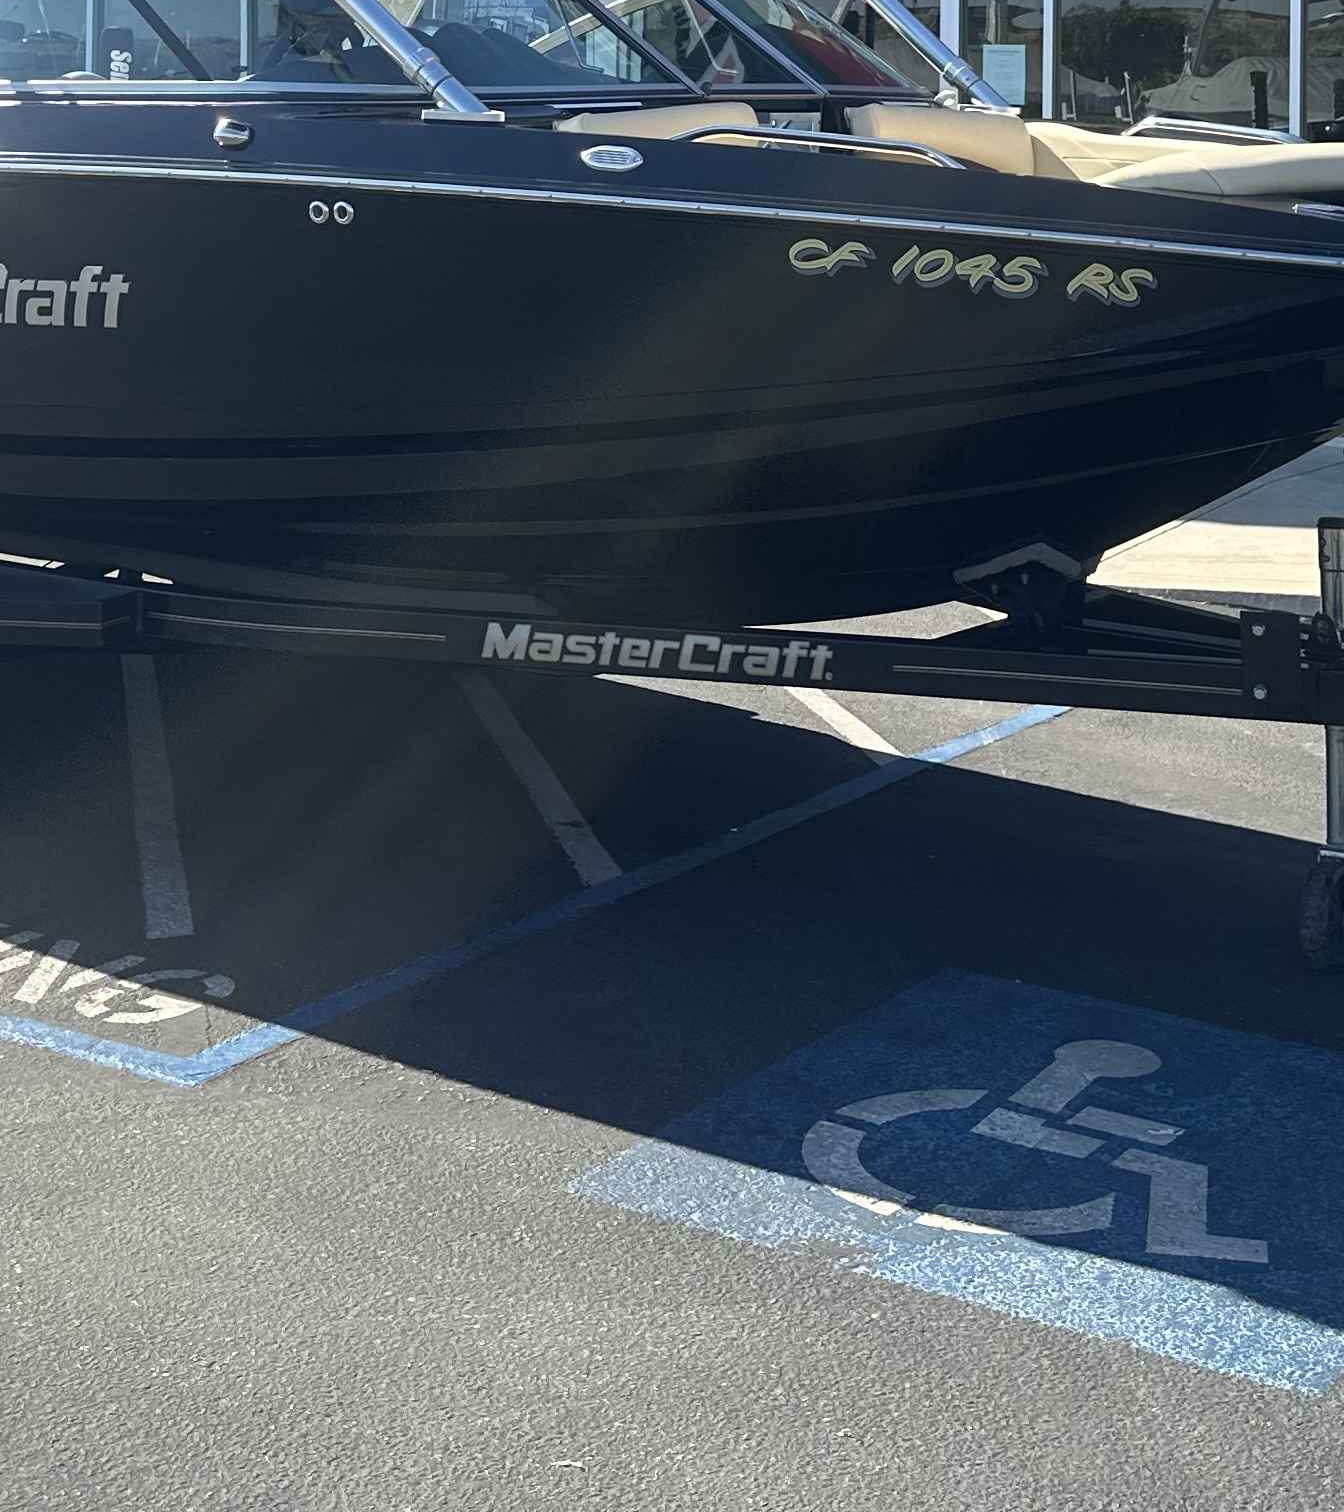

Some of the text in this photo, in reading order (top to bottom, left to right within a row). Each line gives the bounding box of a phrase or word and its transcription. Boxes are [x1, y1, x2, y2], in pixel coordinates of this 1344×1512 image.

[788, 238, 1157, 306] CF 1045 RS
[481, 621, 833, 681] MasterCraft
